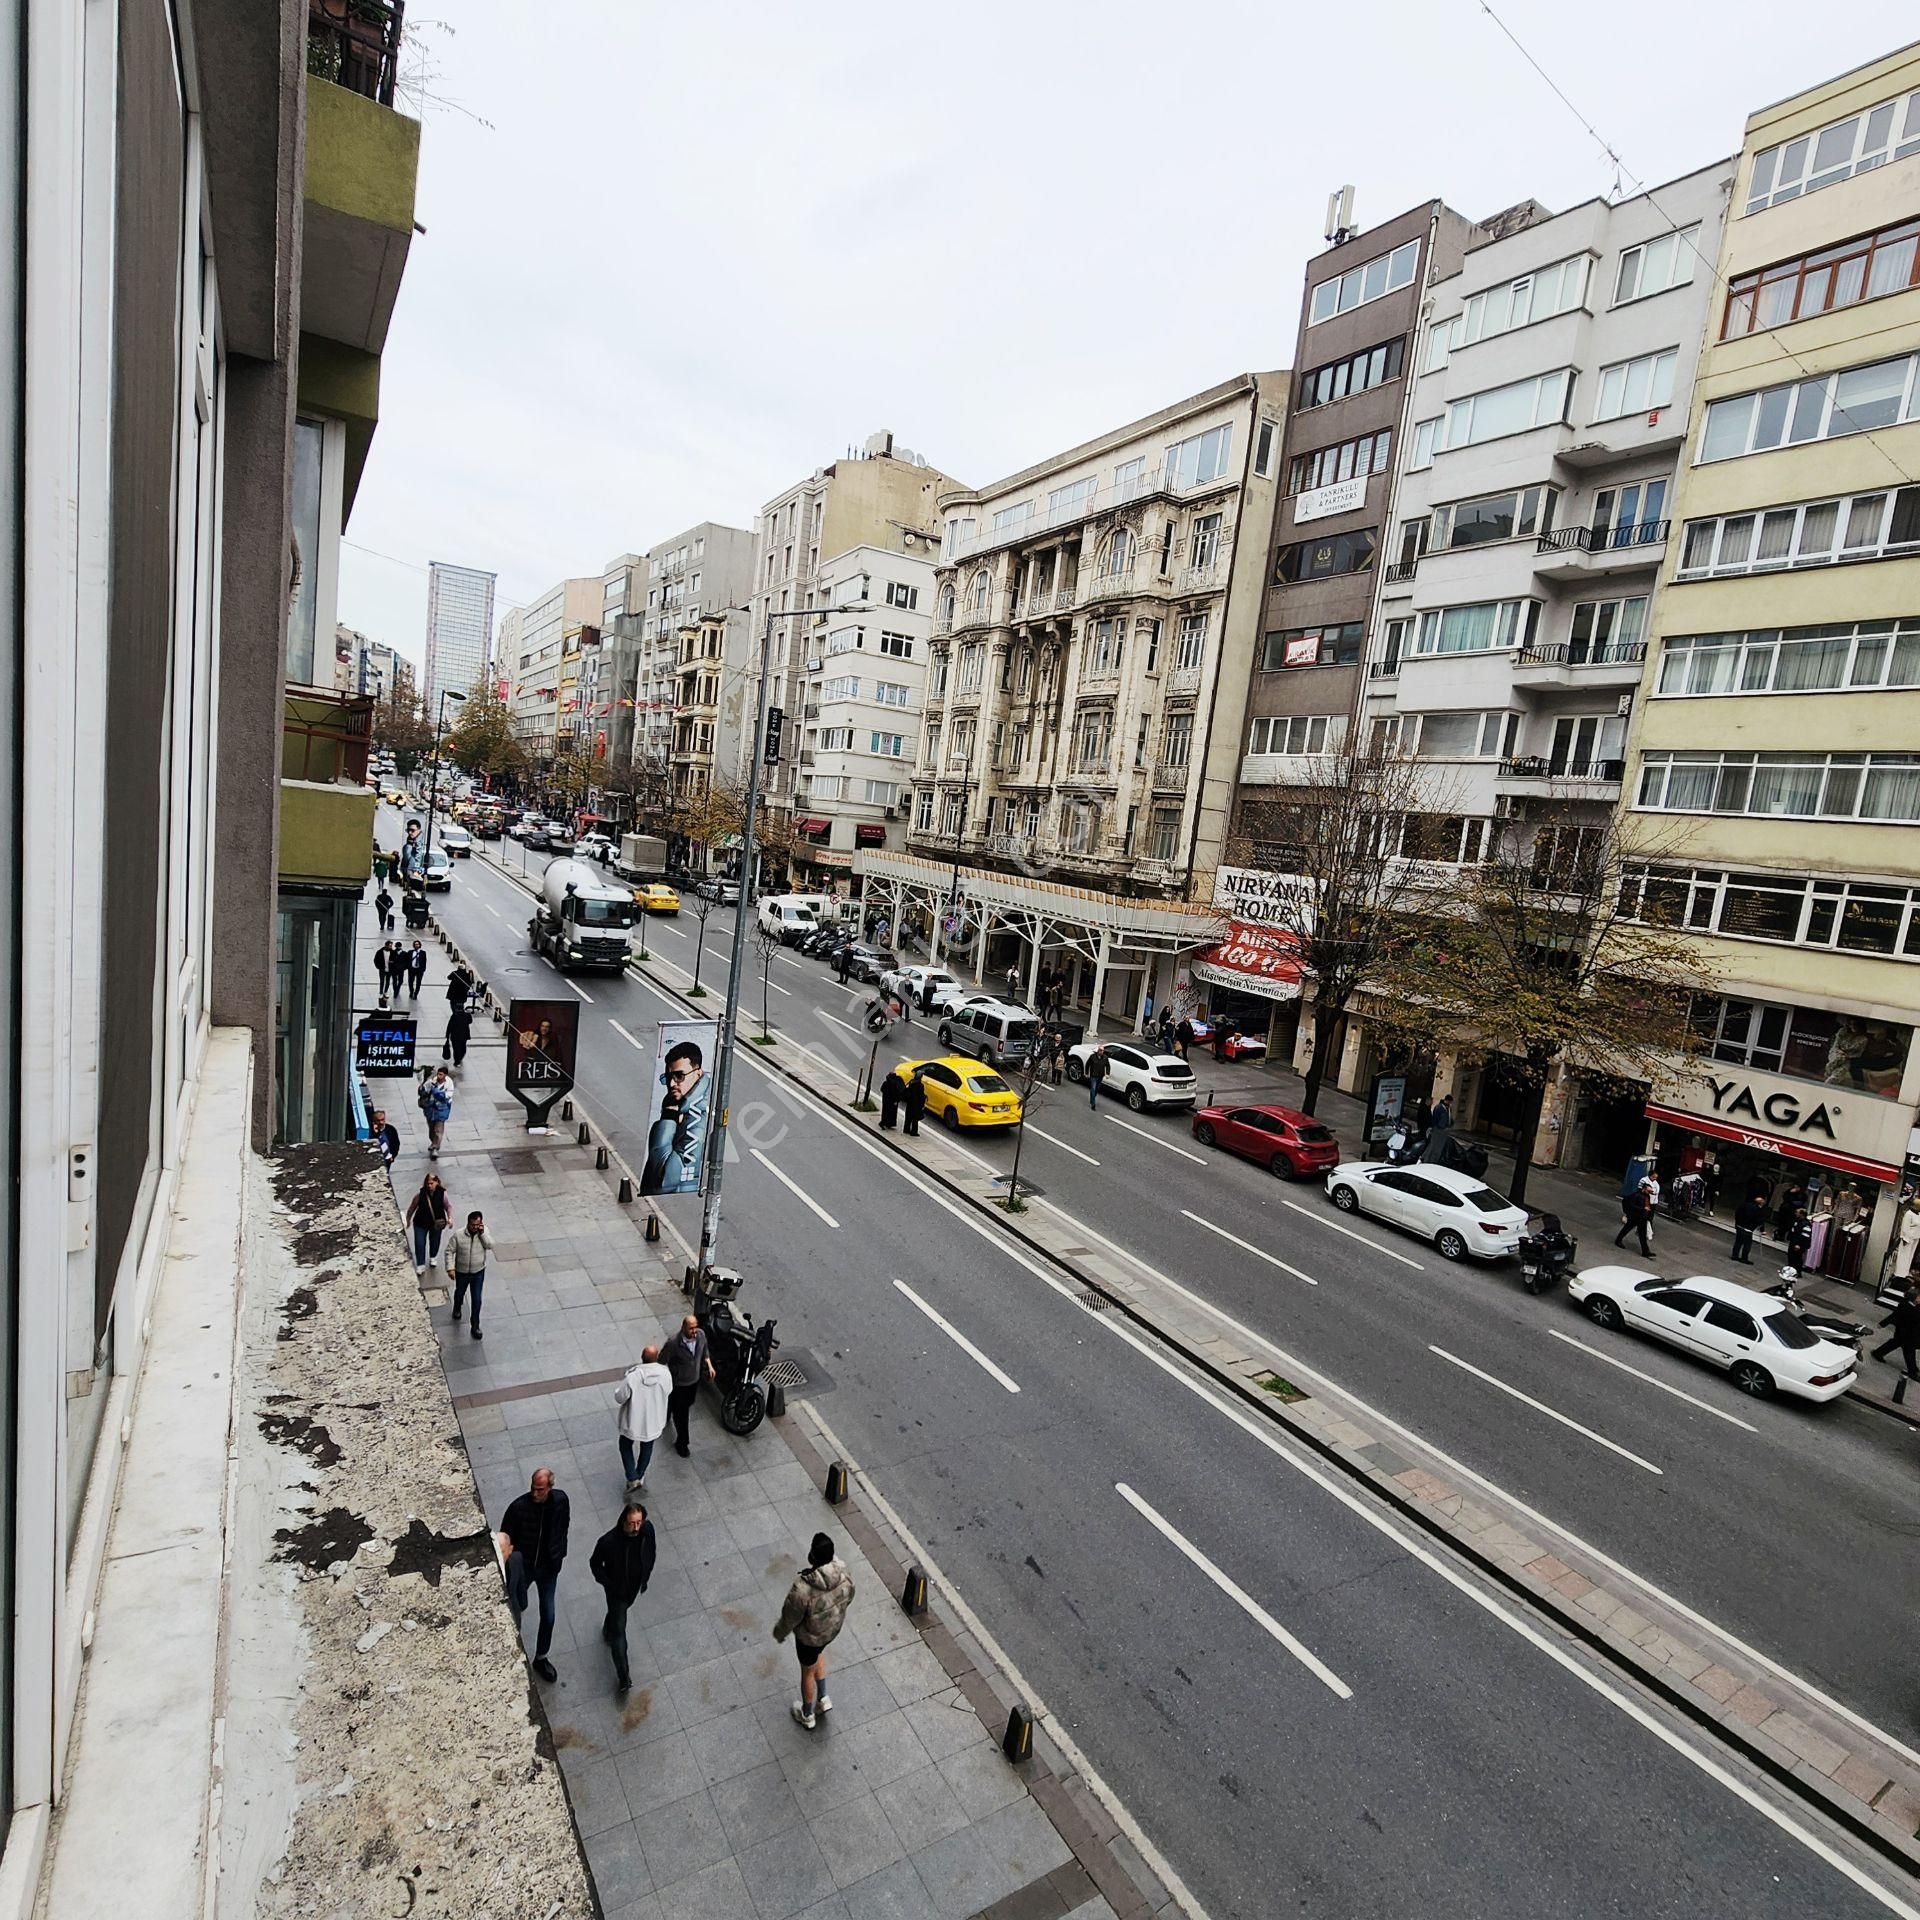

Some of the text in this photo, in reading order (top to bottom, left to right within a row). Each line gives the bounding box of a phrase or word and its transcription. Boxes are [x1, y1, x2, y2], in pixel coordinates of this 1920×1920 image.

[1324, 492, 1358, 506] PARTNERS
[1224, 872, 1311, 903] NİRVANA
[1234, 898, 1292, 925] HOME
[361, 1030, 414, 1042] ETFAL
[367, 1044, 405, 1056] İŞİTME
[358, 1057, 412, 1067] CİHAZLARI
[1742, 1135, 1782, 1154] YAGA
